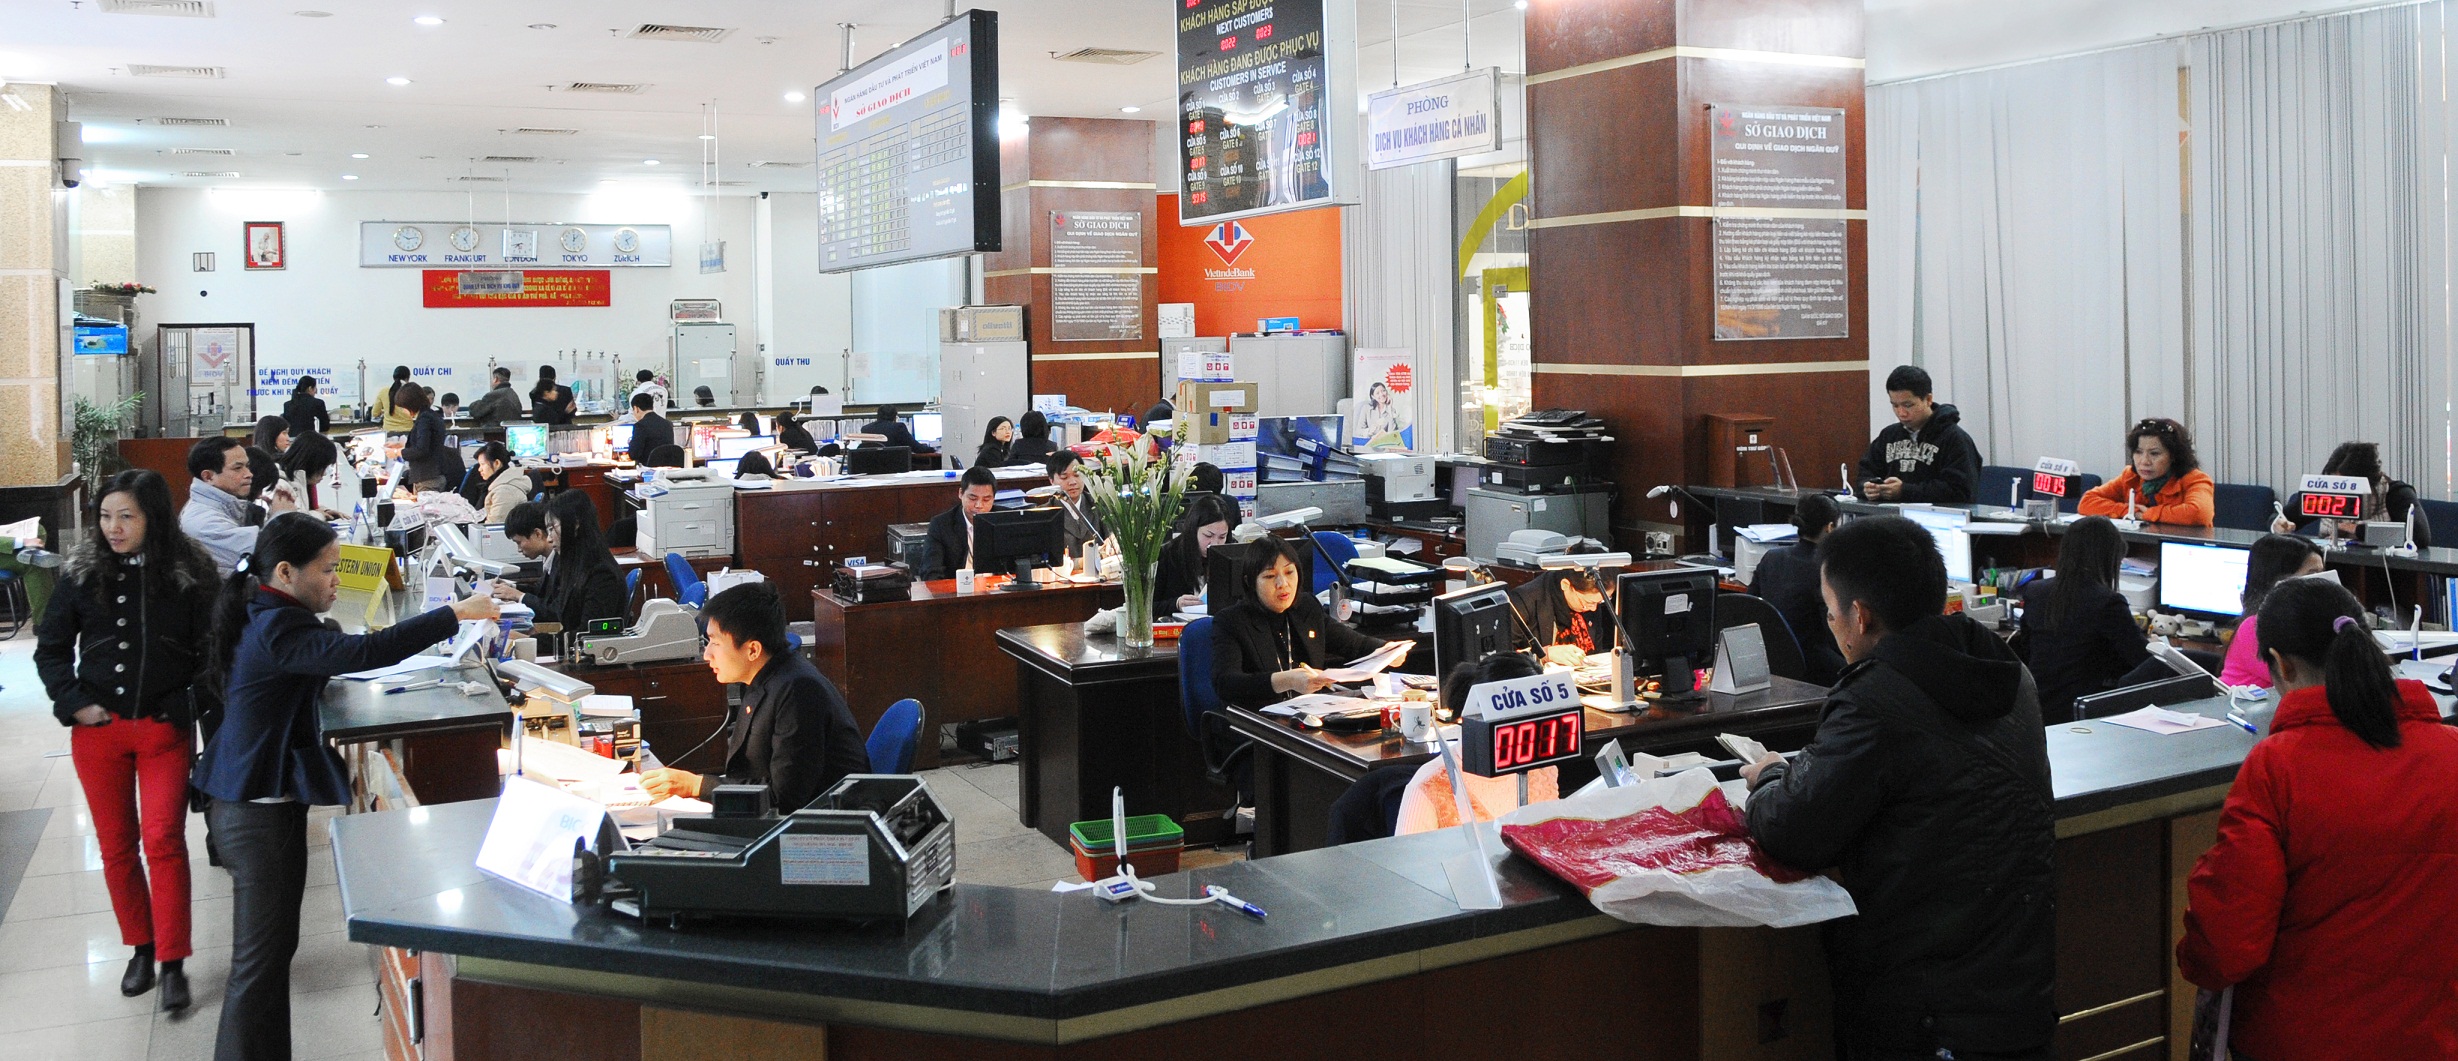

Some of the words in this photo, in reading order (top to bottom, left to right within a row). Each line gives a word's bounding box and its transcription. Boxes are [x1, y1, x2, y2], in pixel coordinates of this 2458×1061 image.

[1180, 11, 1206, 33] KHÁCH
[1207, 4, 1230, 24] HÀNG
[1216, 20, 1233, 36] NEXT
[1234, 6, 1274, 30] CUSTOMERS
[1255, 24, 1273, 40] 0023
[1220, 36, 1237, 52] 0022
[930, 53, 943, 66] NAM
[1180, 64, 1206, 86] KHÁCH
[1207, 57, 1230, 78] HÀNG
[1230, 54, 1253, 72] ĐANG
[1306, 31, 1319, 50] VỤ
[1210, 70, 1249, 92] CUSTOMERS
[1250, 70, 1256, 81] IN
[1258, 60, 1286, 79] SERVICE
[1294, 82, 1309, 94] GATE
[868, 99, 887, 113] GIAO
[889, 87, 911, 104] DỊCH
[1407, 95, 1449, 115] PHÒNG
[1188, 111, 1200, 121] GATE
[1375, 132, 1391, 156] DỊCH
[1392, 130, 1401, 152] VỤ
[1404, 122, 1428, 147] KHÁCH
[1430, 119, 1450, 142] HÀNG
[1452, 114, 1462, 138] CÁ
[1464, 110, 1487, 137] NHÂN
[1745, 121, 1761, 137] SỞ
[1763, 125, 1794, 138] GIAO
[1796, 126, 1827, 140] DỊCH
[1189, 146, 1200, 157] GATE
[1223, 139, 1235, 150] GATE
[1190, 182, 1202, 192] GATE
[1223, 176, 1236, 187] GATE
[1074, 219, 1085, 229] SỞ
[1086, 221, 1108, 229] GIAO
[1109, 222, 1130, 230] DỊCH
[406, 254, 428, 262] YORK
[797, 358, 810, 366] THU
[306, 366, 331, 375] KHÁCH
[438, 367, 452, 376] CHI
[2035, 472, 2065, 495] 0015
[2307, 478, 2328, 488] CỬA
[2332, 479, 2348, 490] SỐ
[2350, 482, 2357, 490] 8
[2304, 494, 2360, 516] 0021
[335, 558, 359, 574] ESTERN
[360, 559, 382, 577] UNION
[602, 622, 608, 630] 0
[1491, 686, 1528, 710] CỬA
[1530, 680, 1554, 704] SỐ
[1557, 683, 1569, 699] 5
[1496, 713, 1578, 768] 0017
